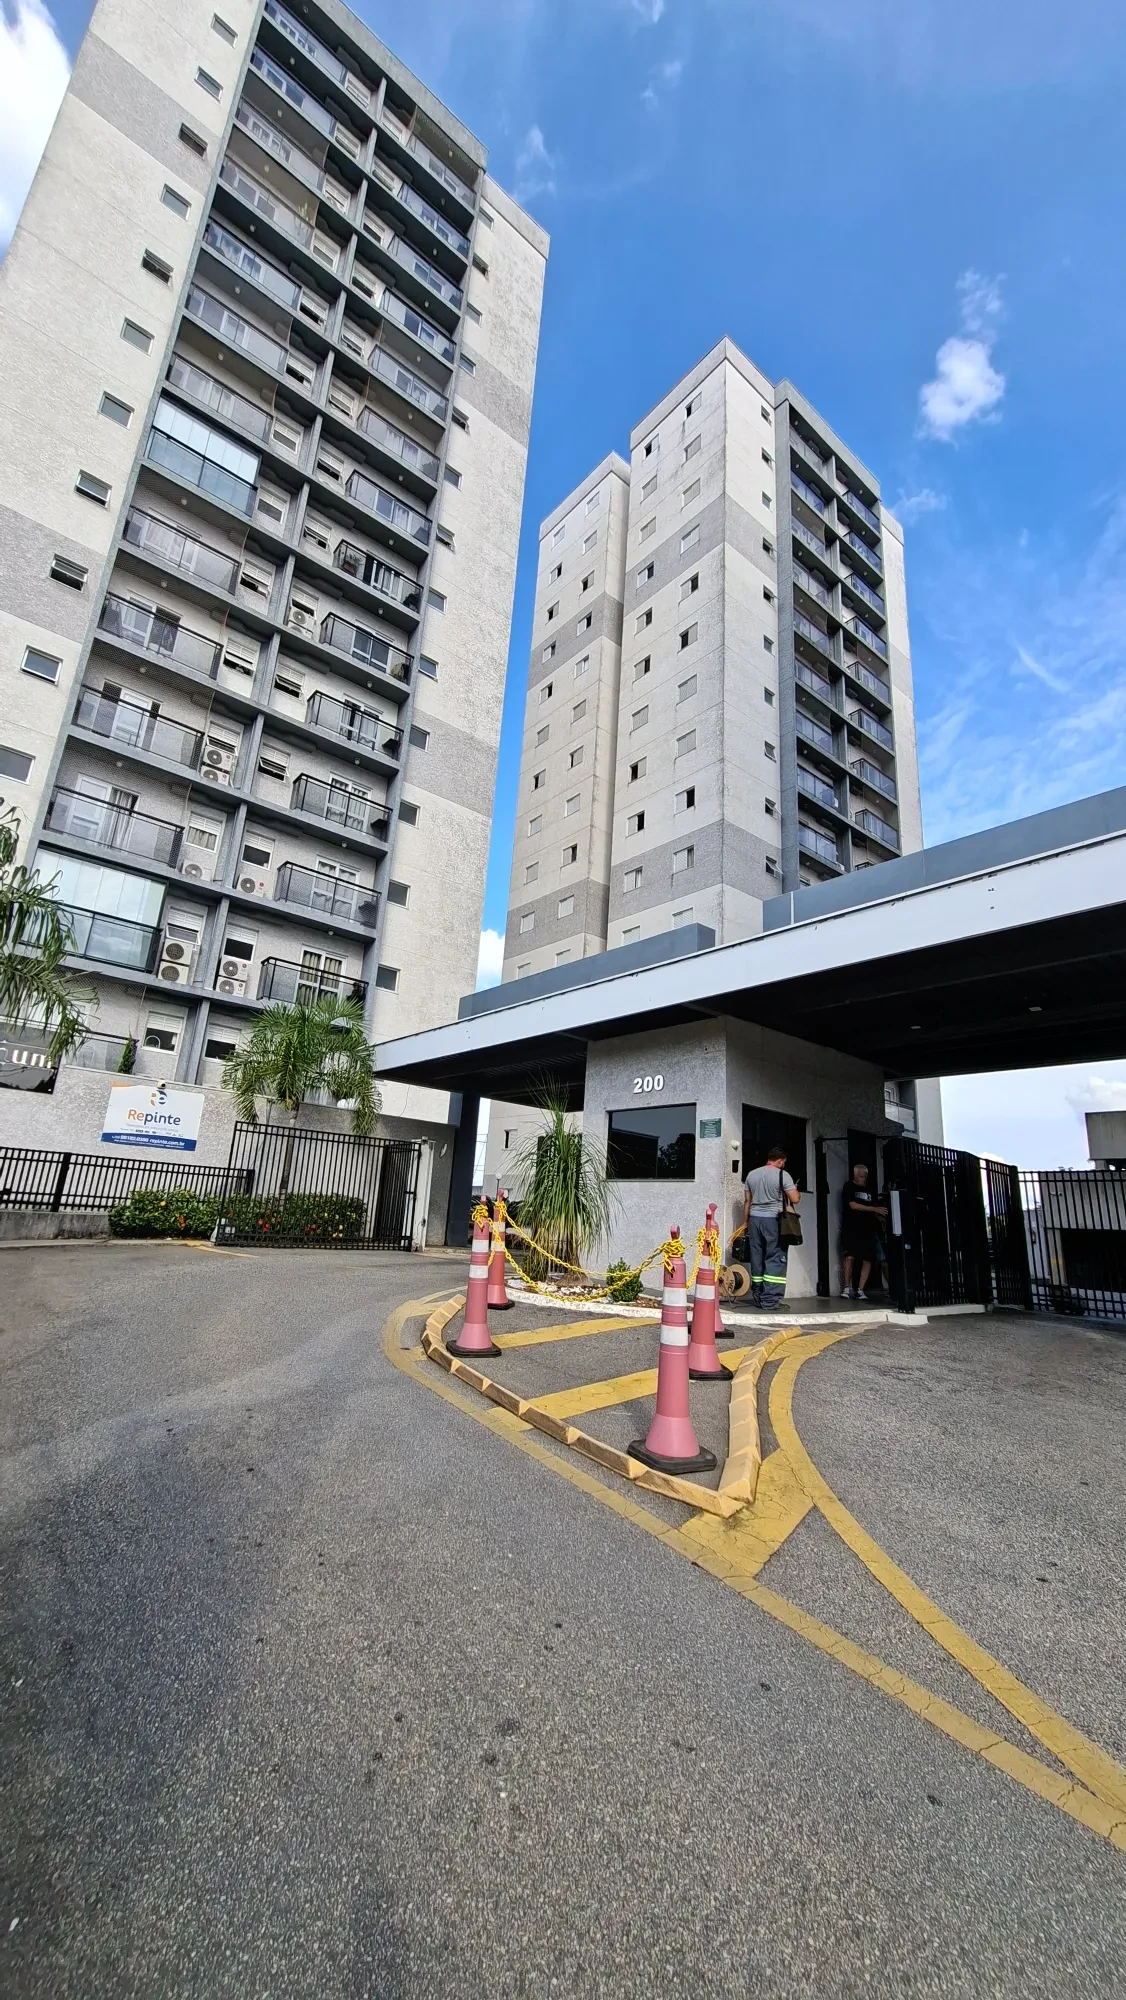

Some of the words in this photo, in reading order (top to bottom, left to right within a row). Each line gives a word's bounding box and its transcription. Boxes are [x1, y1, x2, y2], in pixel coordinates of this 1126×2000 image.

[633, 1074, 665, 1094] 200
[127, 1109, 181, 1126] Repinte
[149, 1138, 186, 1147] repinte.com.br
